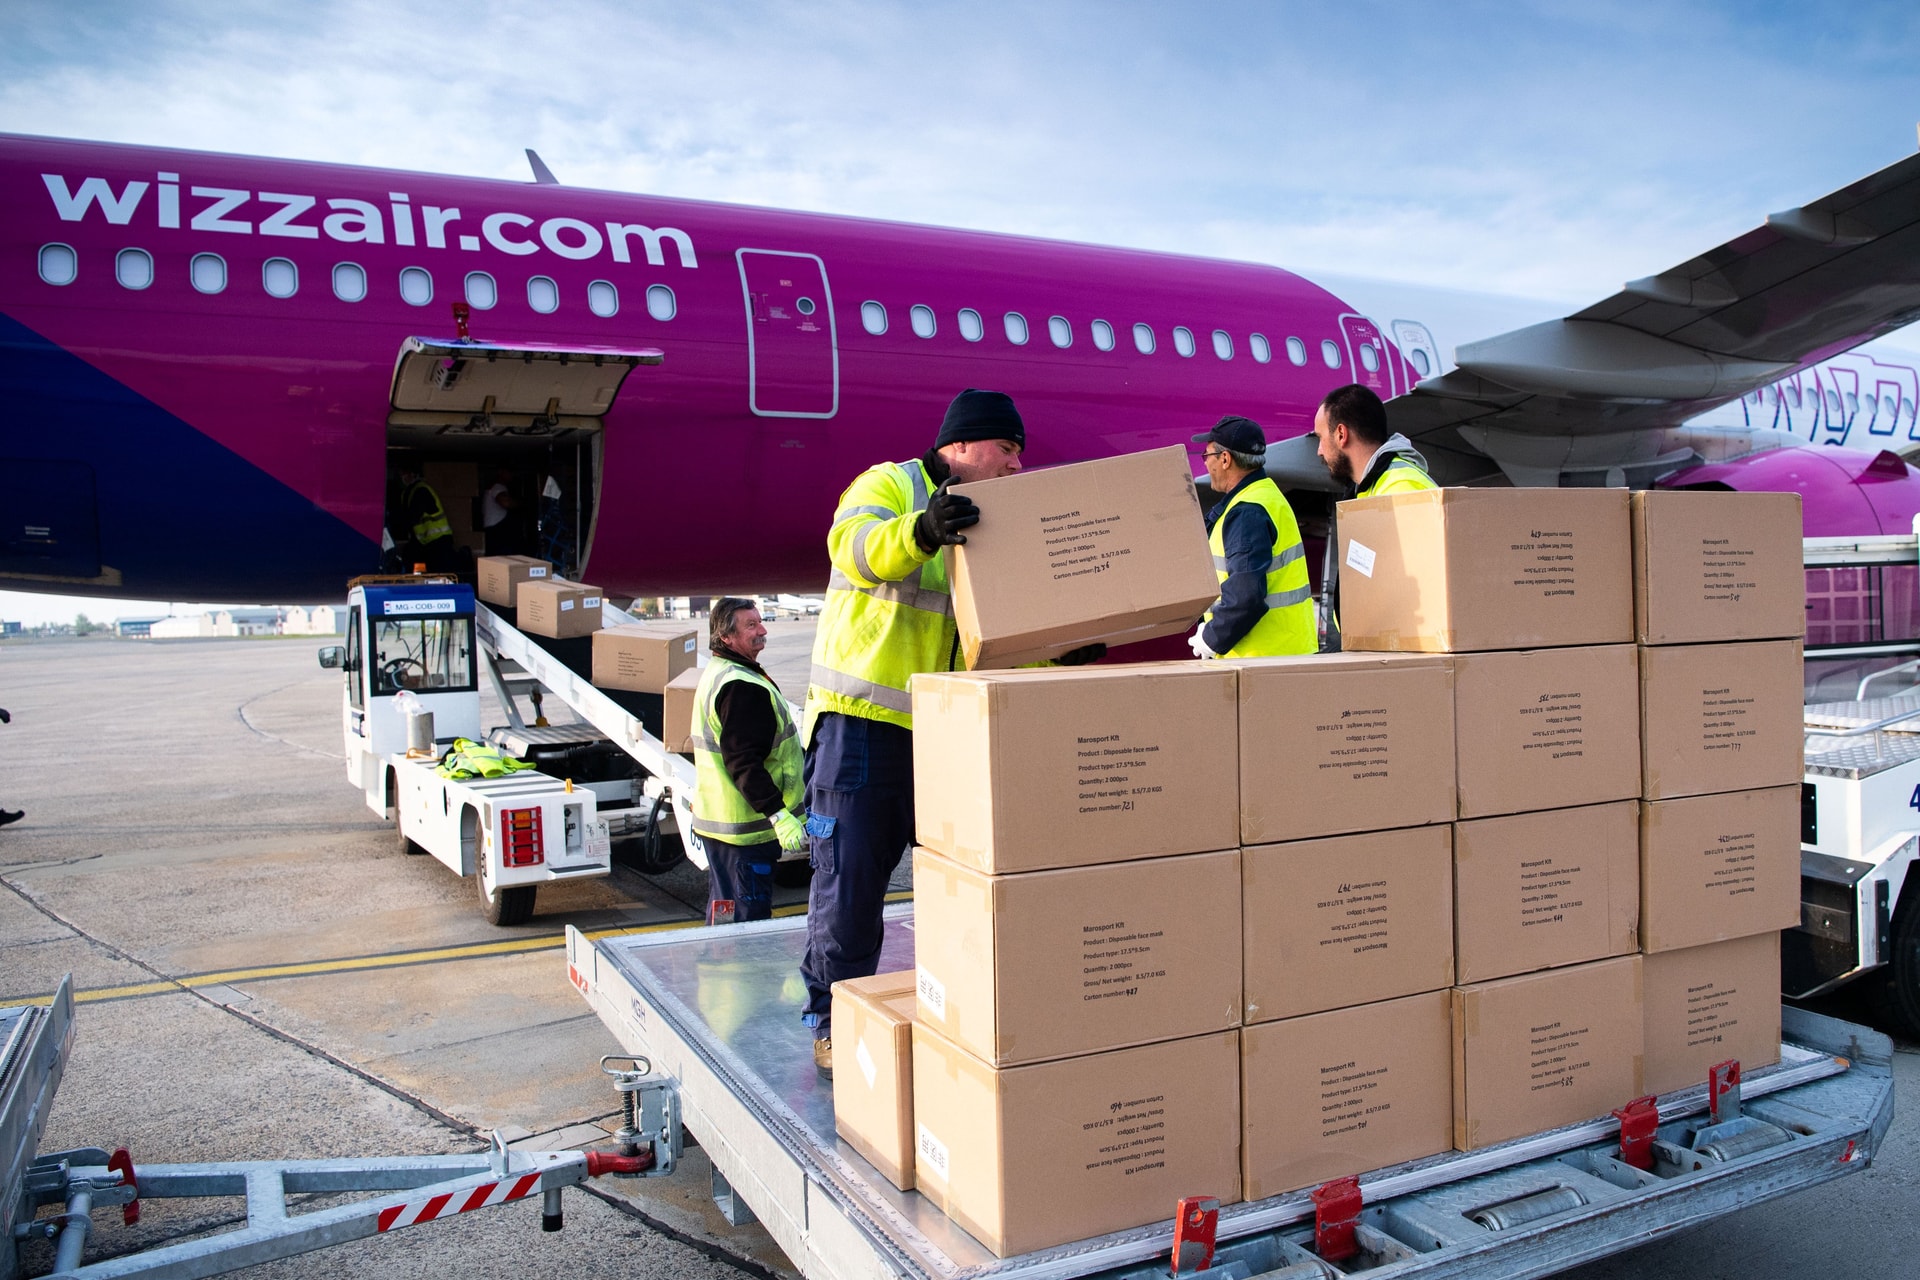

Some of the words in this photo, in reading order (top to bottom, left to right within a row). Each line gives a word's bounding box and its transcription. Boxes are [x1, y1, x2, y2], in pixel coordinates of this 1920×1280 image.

[41, 172, 698, 268] wizzair.com
[1041, 513, 1070, 522] Marosport
[1067, 520, 1094, 529] Disposable
[1083, 924, 1114, 932] Marosport
[1109, 934, 1136, 942] Disposable
